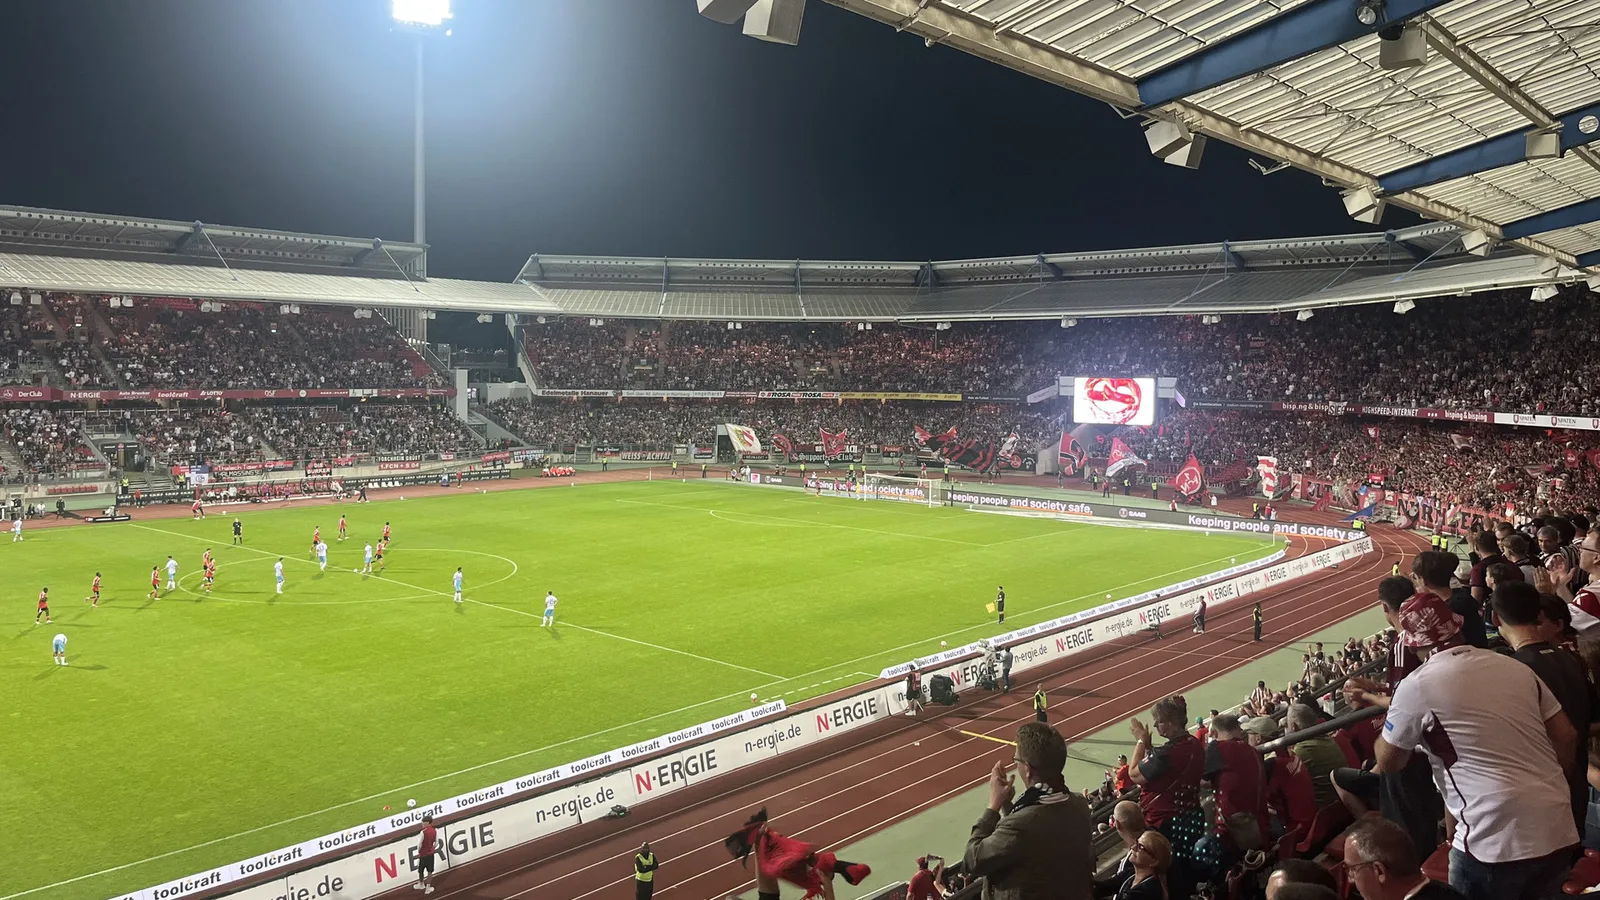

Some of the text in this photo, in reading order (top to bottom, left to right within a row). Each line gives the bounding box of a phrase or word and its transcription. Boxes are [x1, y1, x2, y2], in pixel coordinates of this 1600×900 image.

[1362, 405, 1419, 417] HIGHSPEED-INTERNET
[1444, 409, 1488, 423] bisping & bisping
[1557, 416, 1577, 425] SPATEN
[621, 451, 641, 460] WEISS
[980, 496, 1008, 508] people
[1010, 497, 1028, 507] and
[1029, 499, 1067, 513] society
[1067, 502, 1093, 515] safe.
[1128, 510, 1147, 518] SAAB
[1188, 515, 1366, 543] Keeping people and society saf
[1016, 627, 1036, 638] toolcraft
[1038, 621, 1057, 631] toolcraft
[993, 633, 1014, 645] toolcraft
[943, 648, 967, 660] toolcraft
[1014, 645, 1048, 664] n-ergie.de
[750, 702, 782, 719] toolcraft
[711, 713, 744, 731] toolcraft
[667, 725, 703, 744] toolcraft
[744, 723, 802, 753] n-ergie.de
[620, 740, 660, 759] toolcraft
[570, 754, 612, 774] toolcraft
[515, 769, 561, 791] toolcraft
[456, 785, 504, 809] toolcraft
[535, 786, 614, 823] n-ergie.de
[390, 804, 443, 829] toolcraft
[318, 825, 376, 851] toolcraft
[240, 846, 303, 875] toolcraft
[152, 871, 222, 900] toolcraft
